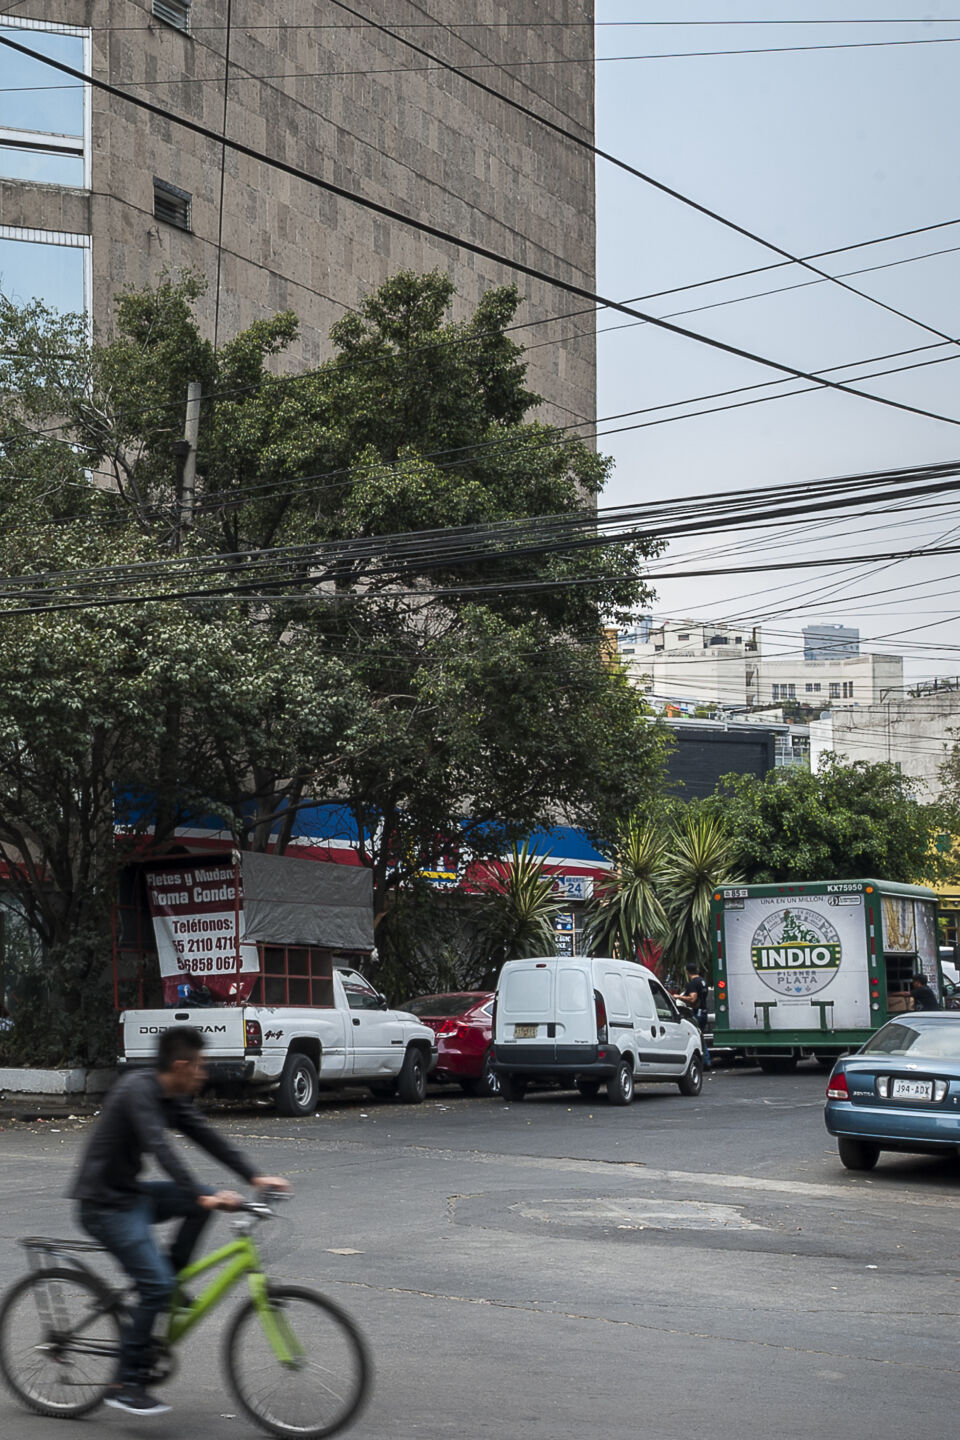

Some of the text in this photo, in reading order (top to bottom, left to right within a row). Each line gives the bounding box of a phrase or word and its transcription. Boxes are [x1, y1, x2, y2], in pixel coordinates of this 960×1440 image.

[146, 873, 182, 886] Fletes
[184, 873, 193, 886] y
[567, 883, 582, 893] 24
[827, 884, 863, 893] KX75950
[172, 918, 234, 934] Teléfonos:
[187, 937, 213, 953] 2110
[761, 947, 831, 967] INDIO
[176, 957, 213, 972] 56858
[777, 976, 818, 984] PLATA
[194, 1025, 227, 1033] RAM
